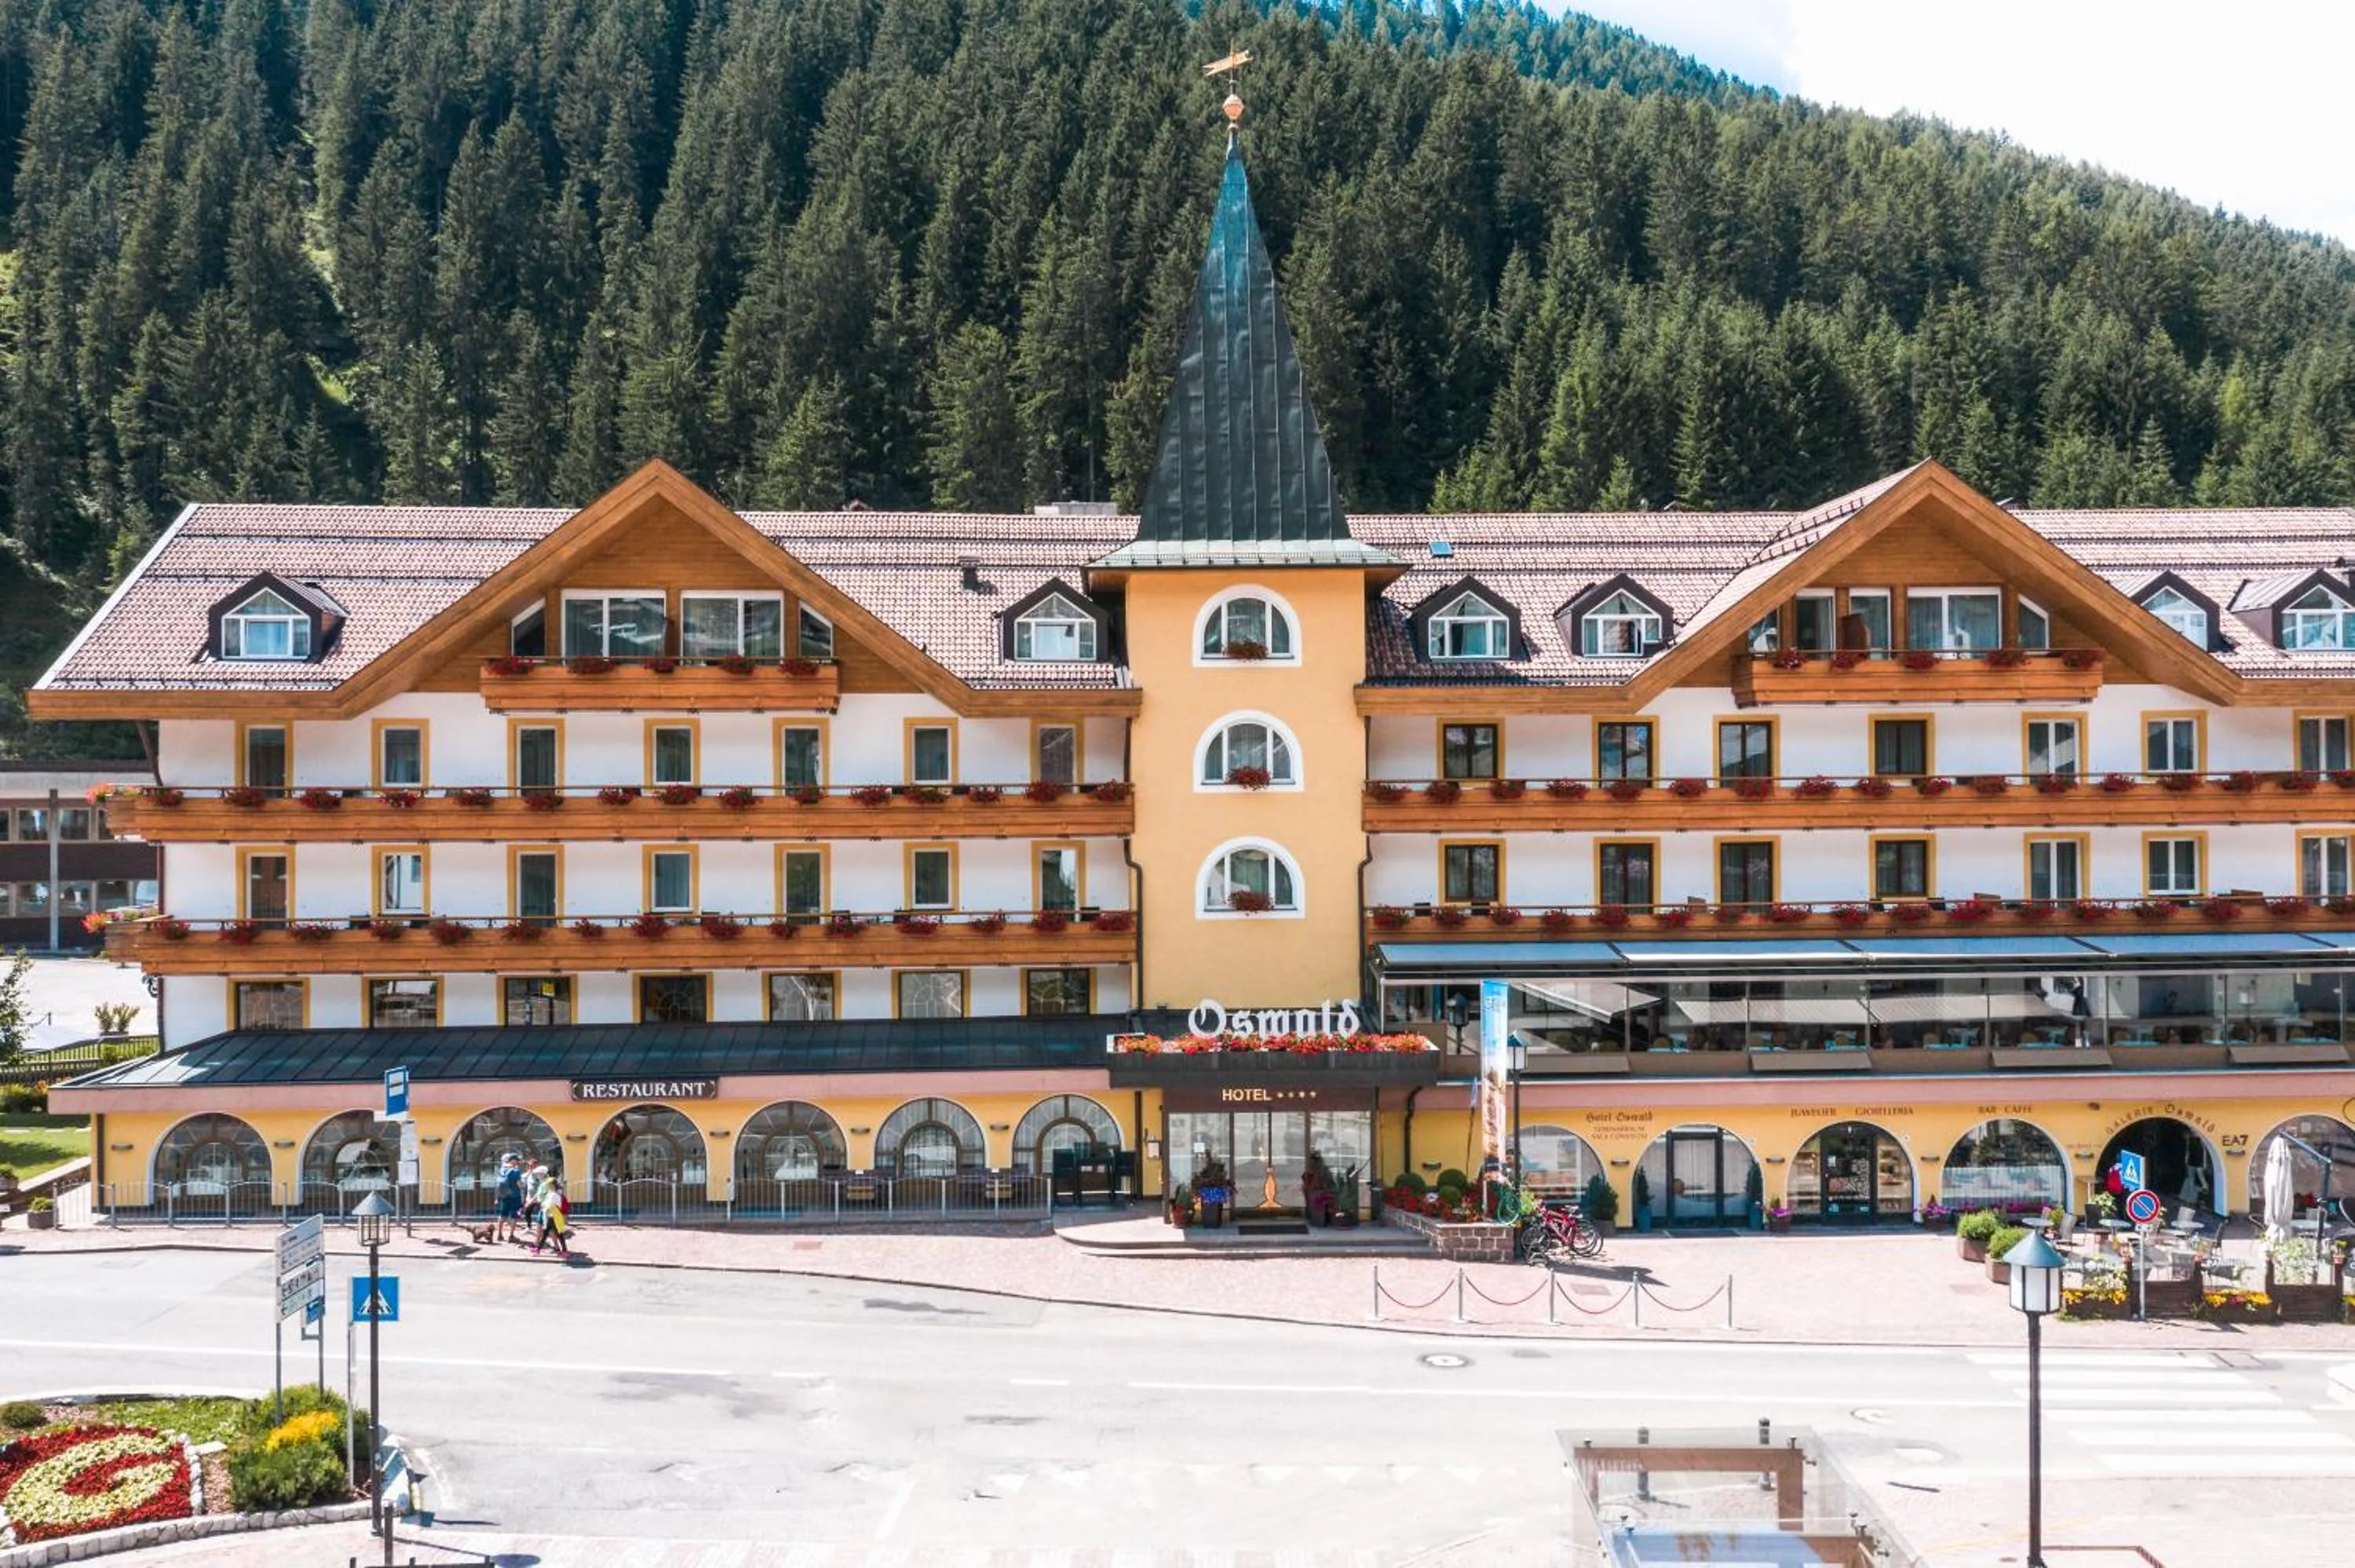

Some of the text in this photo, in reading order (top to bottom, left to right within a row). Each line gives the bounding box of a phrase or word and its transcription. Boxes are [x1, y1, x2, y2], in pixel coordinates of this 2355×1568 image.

[1188, 998, 1360, 1041] Oswald
[582, 1082, 706, 1098] RESTAURANT
[1221, 1088, 1272, 1101] HOTEL
[1978, 1105, 1997, 1114] BAR
[2222, 1134, 2249, 1151] EA7
